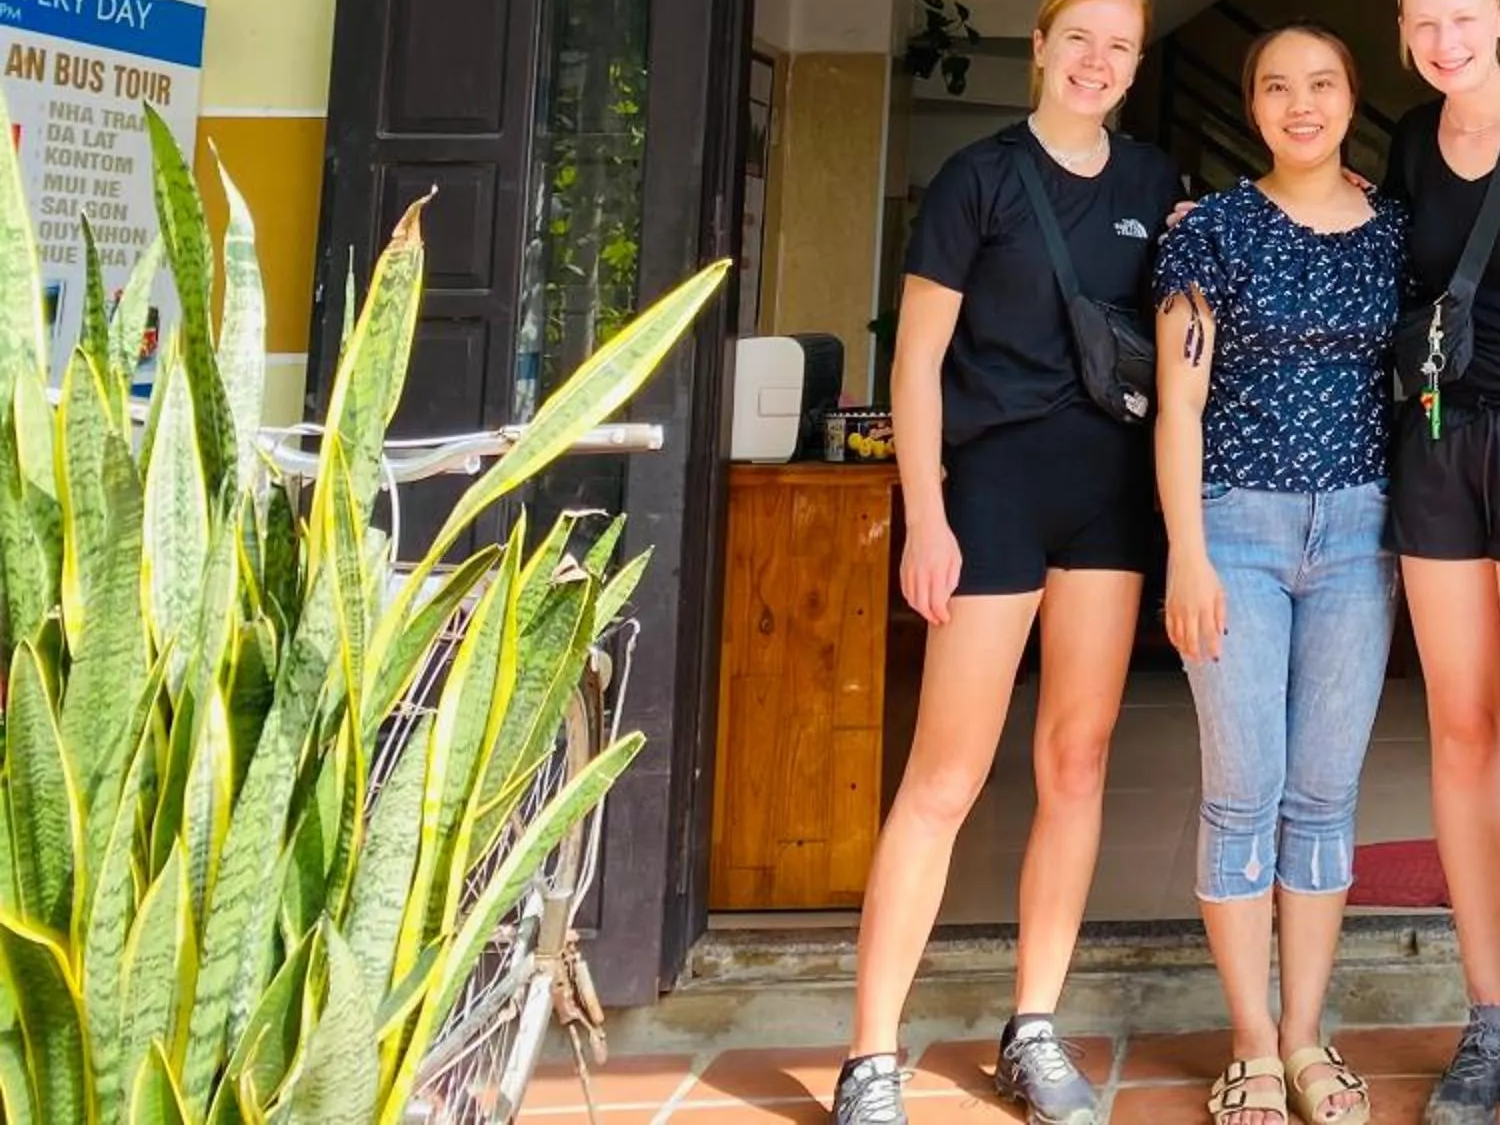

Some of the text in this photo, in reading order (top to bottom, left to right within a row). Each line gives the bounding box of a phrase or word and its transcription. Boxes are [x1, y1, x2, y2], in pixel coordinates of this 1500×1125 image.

[5, 43, 172, 106] AN BUS TOUR
[48, 101, 94, 124] NHA
[46, 124, 118, 150] DA LAT
[44, 147, 134, 174] KONTOM
[43, 174, 122, 198] MUI NE
[41, 197, 78, 216] SAI
